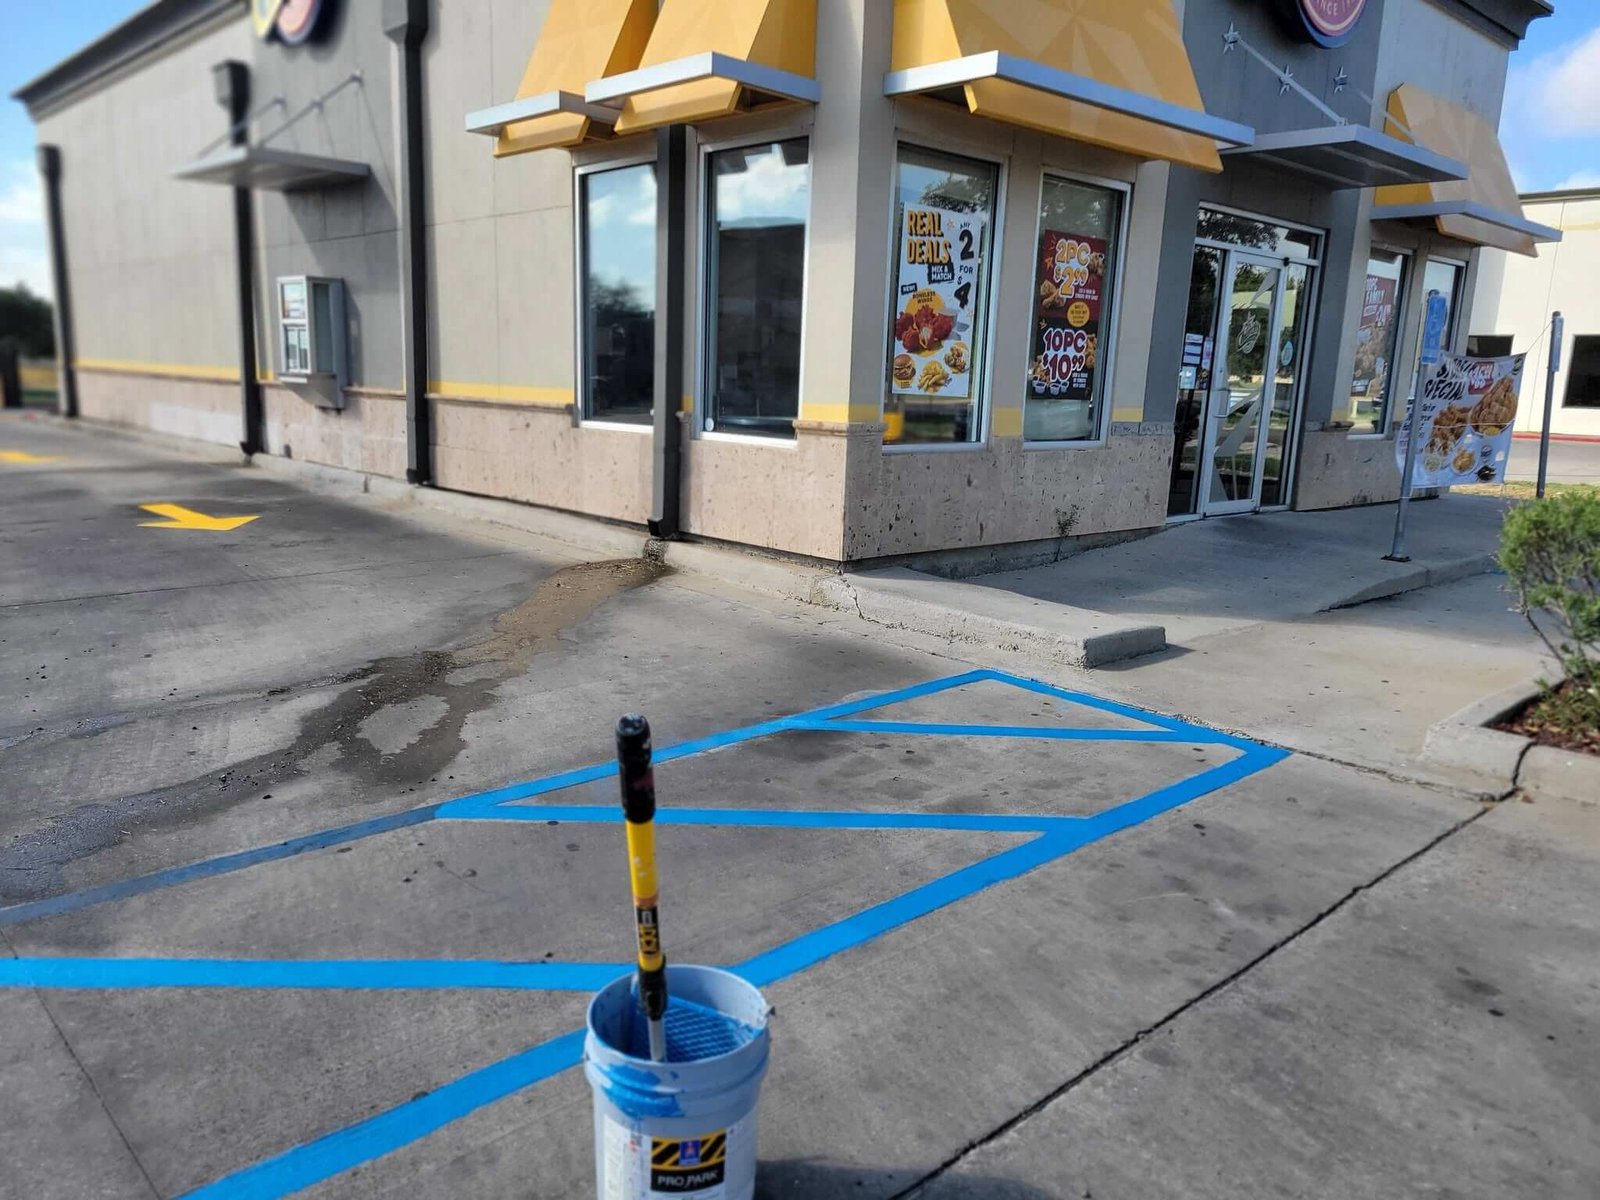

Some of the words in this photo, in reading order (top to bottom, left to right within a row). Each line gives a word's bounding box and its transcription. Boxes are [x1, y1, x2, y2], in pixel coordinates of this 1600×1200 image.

[907, 210, 944, 237] REAL
[907, 239, 952, 264] DEALS
[959, 229, 975, 260] 2
[1055, 238, 1091, 266] 2PC
[931, 272, 952, 280] MATCH
[932, 265, 944, 273] MIX
[960, 265, 973, 275] FOR
[1043, 328, 1087, 354] 10PC
[657, 1175, 685, 1187] PRO
[684, 1169, 719, 1189] PARK
